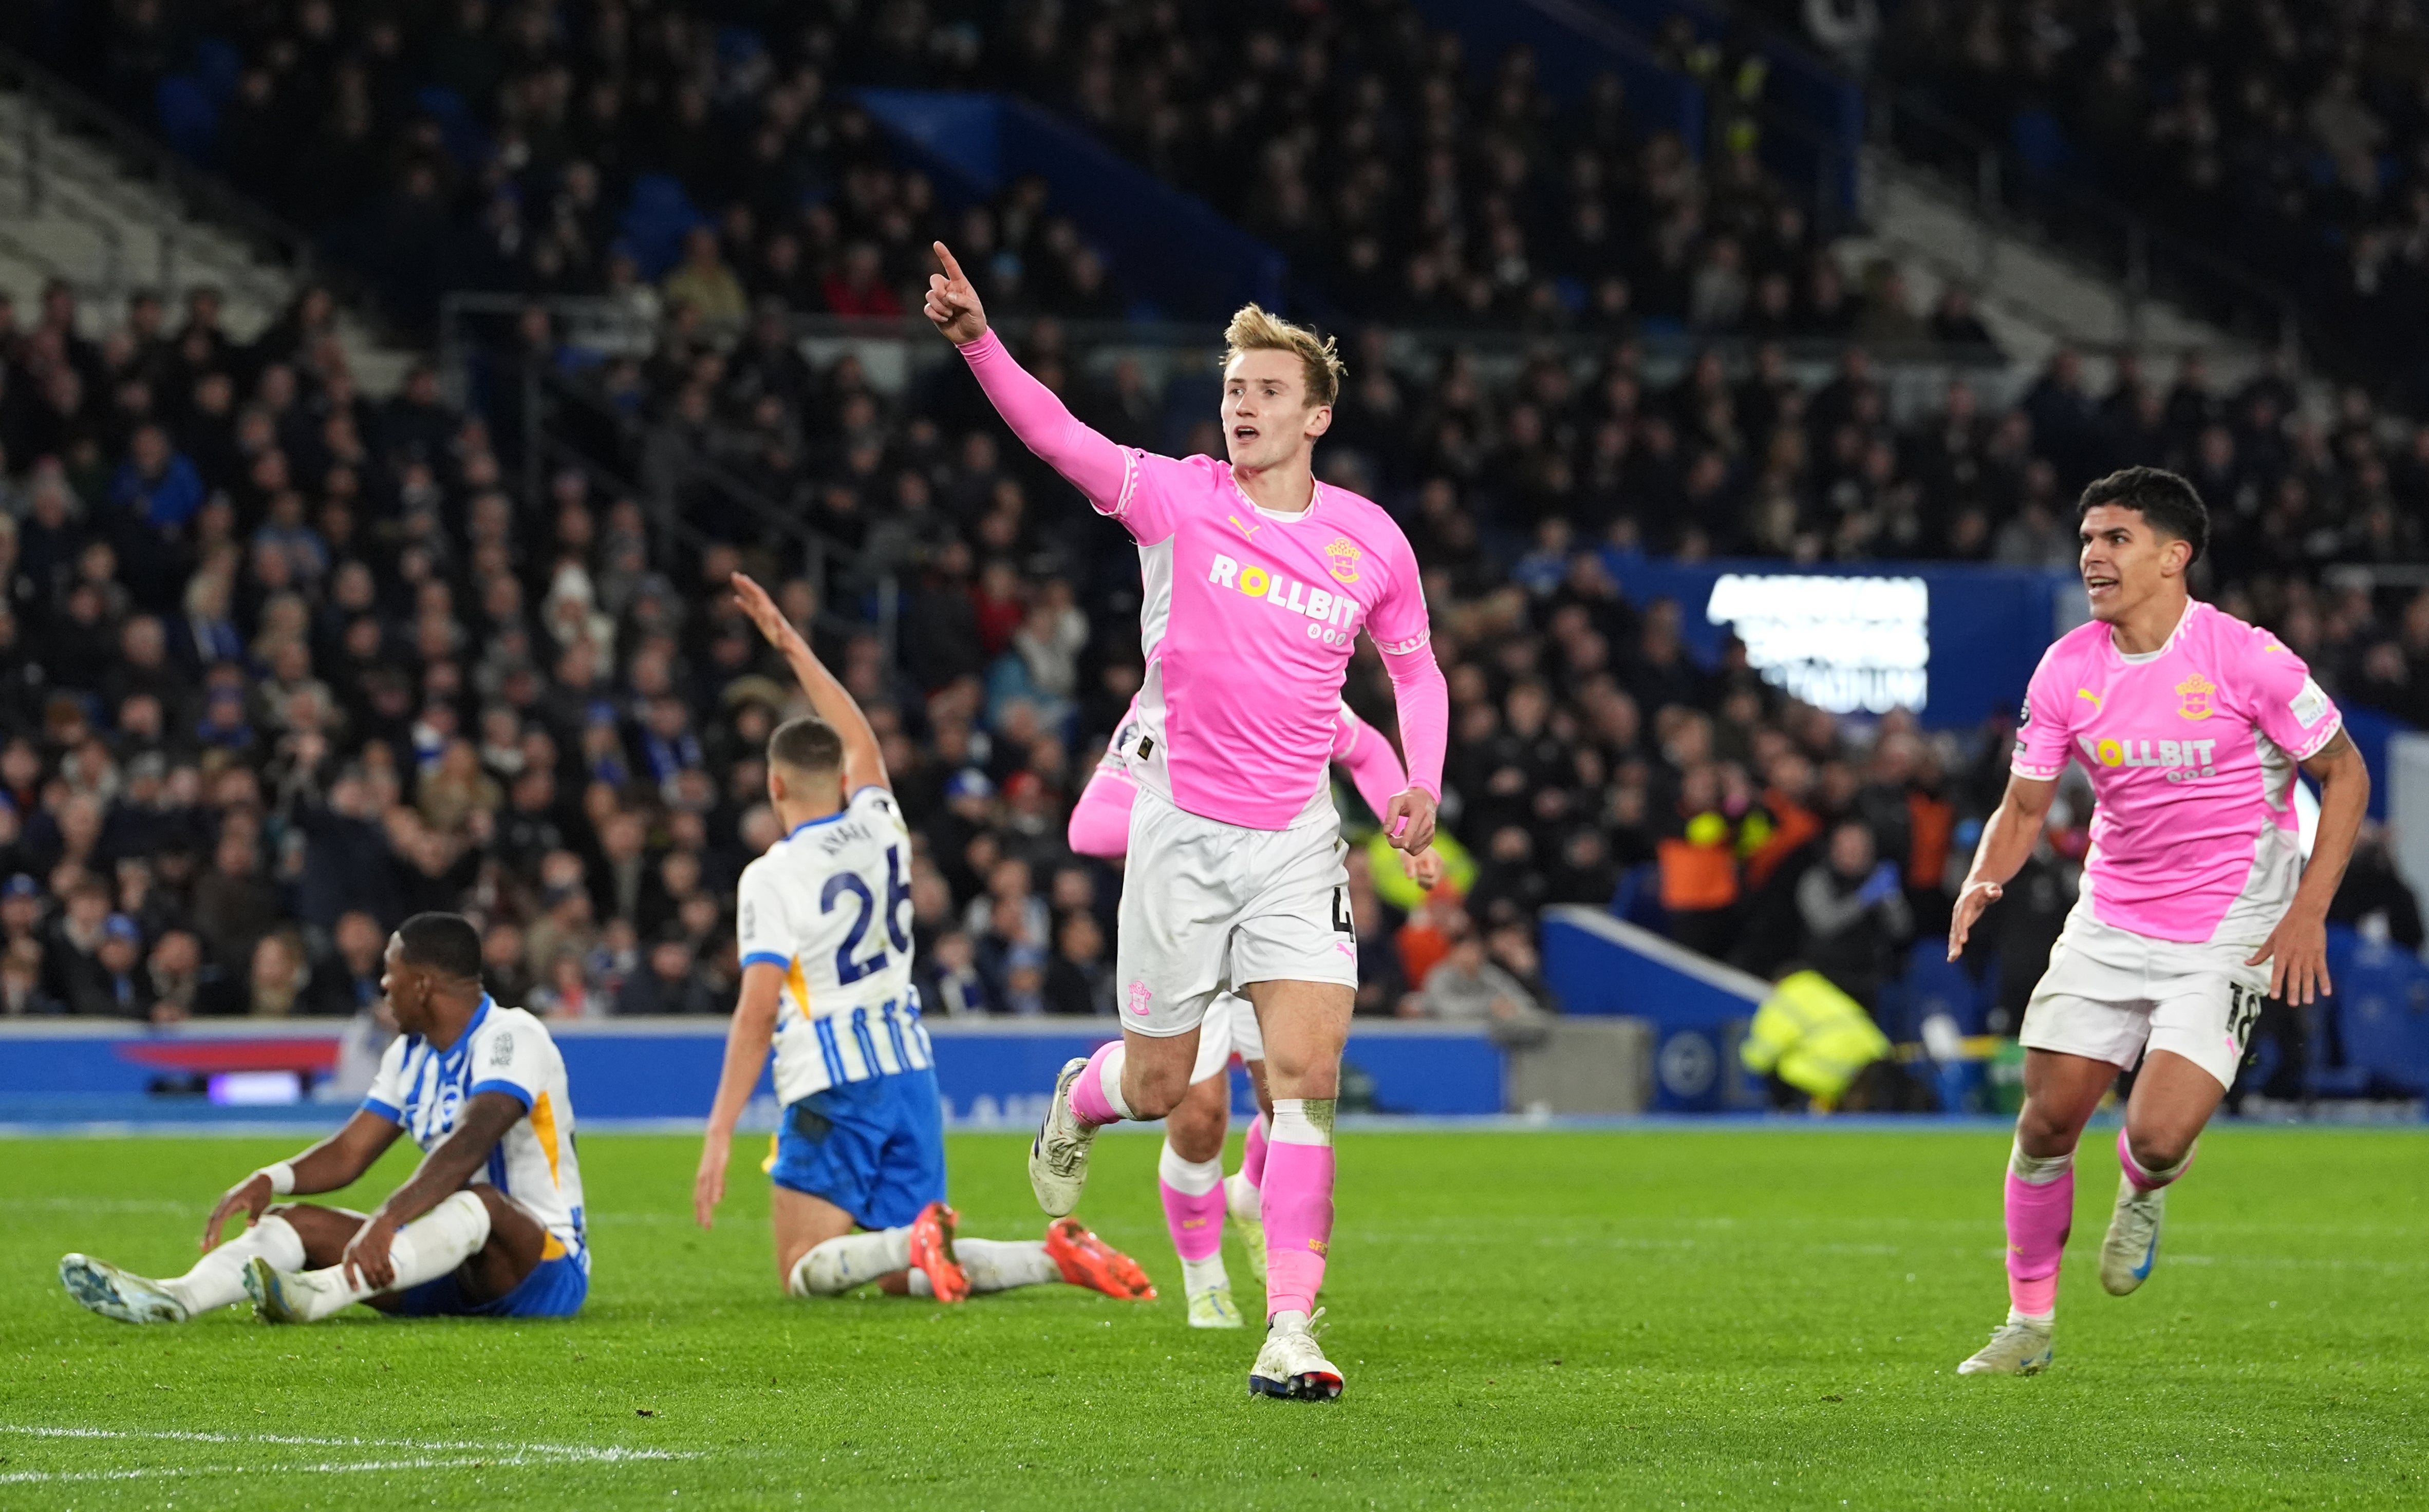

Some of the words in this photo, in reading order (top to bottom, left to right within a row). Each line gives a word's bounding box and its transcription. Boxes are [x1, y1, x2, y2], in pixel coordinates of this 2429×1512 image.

[1208, 553, 1360, 629] ROLLBIT
[819, 845, 911, 986] 26
[1332, 886, 1355, 943] 4
[2225, 981, 2262, 1048] 18
[1308, 1238, 1328, 1254] SFC
